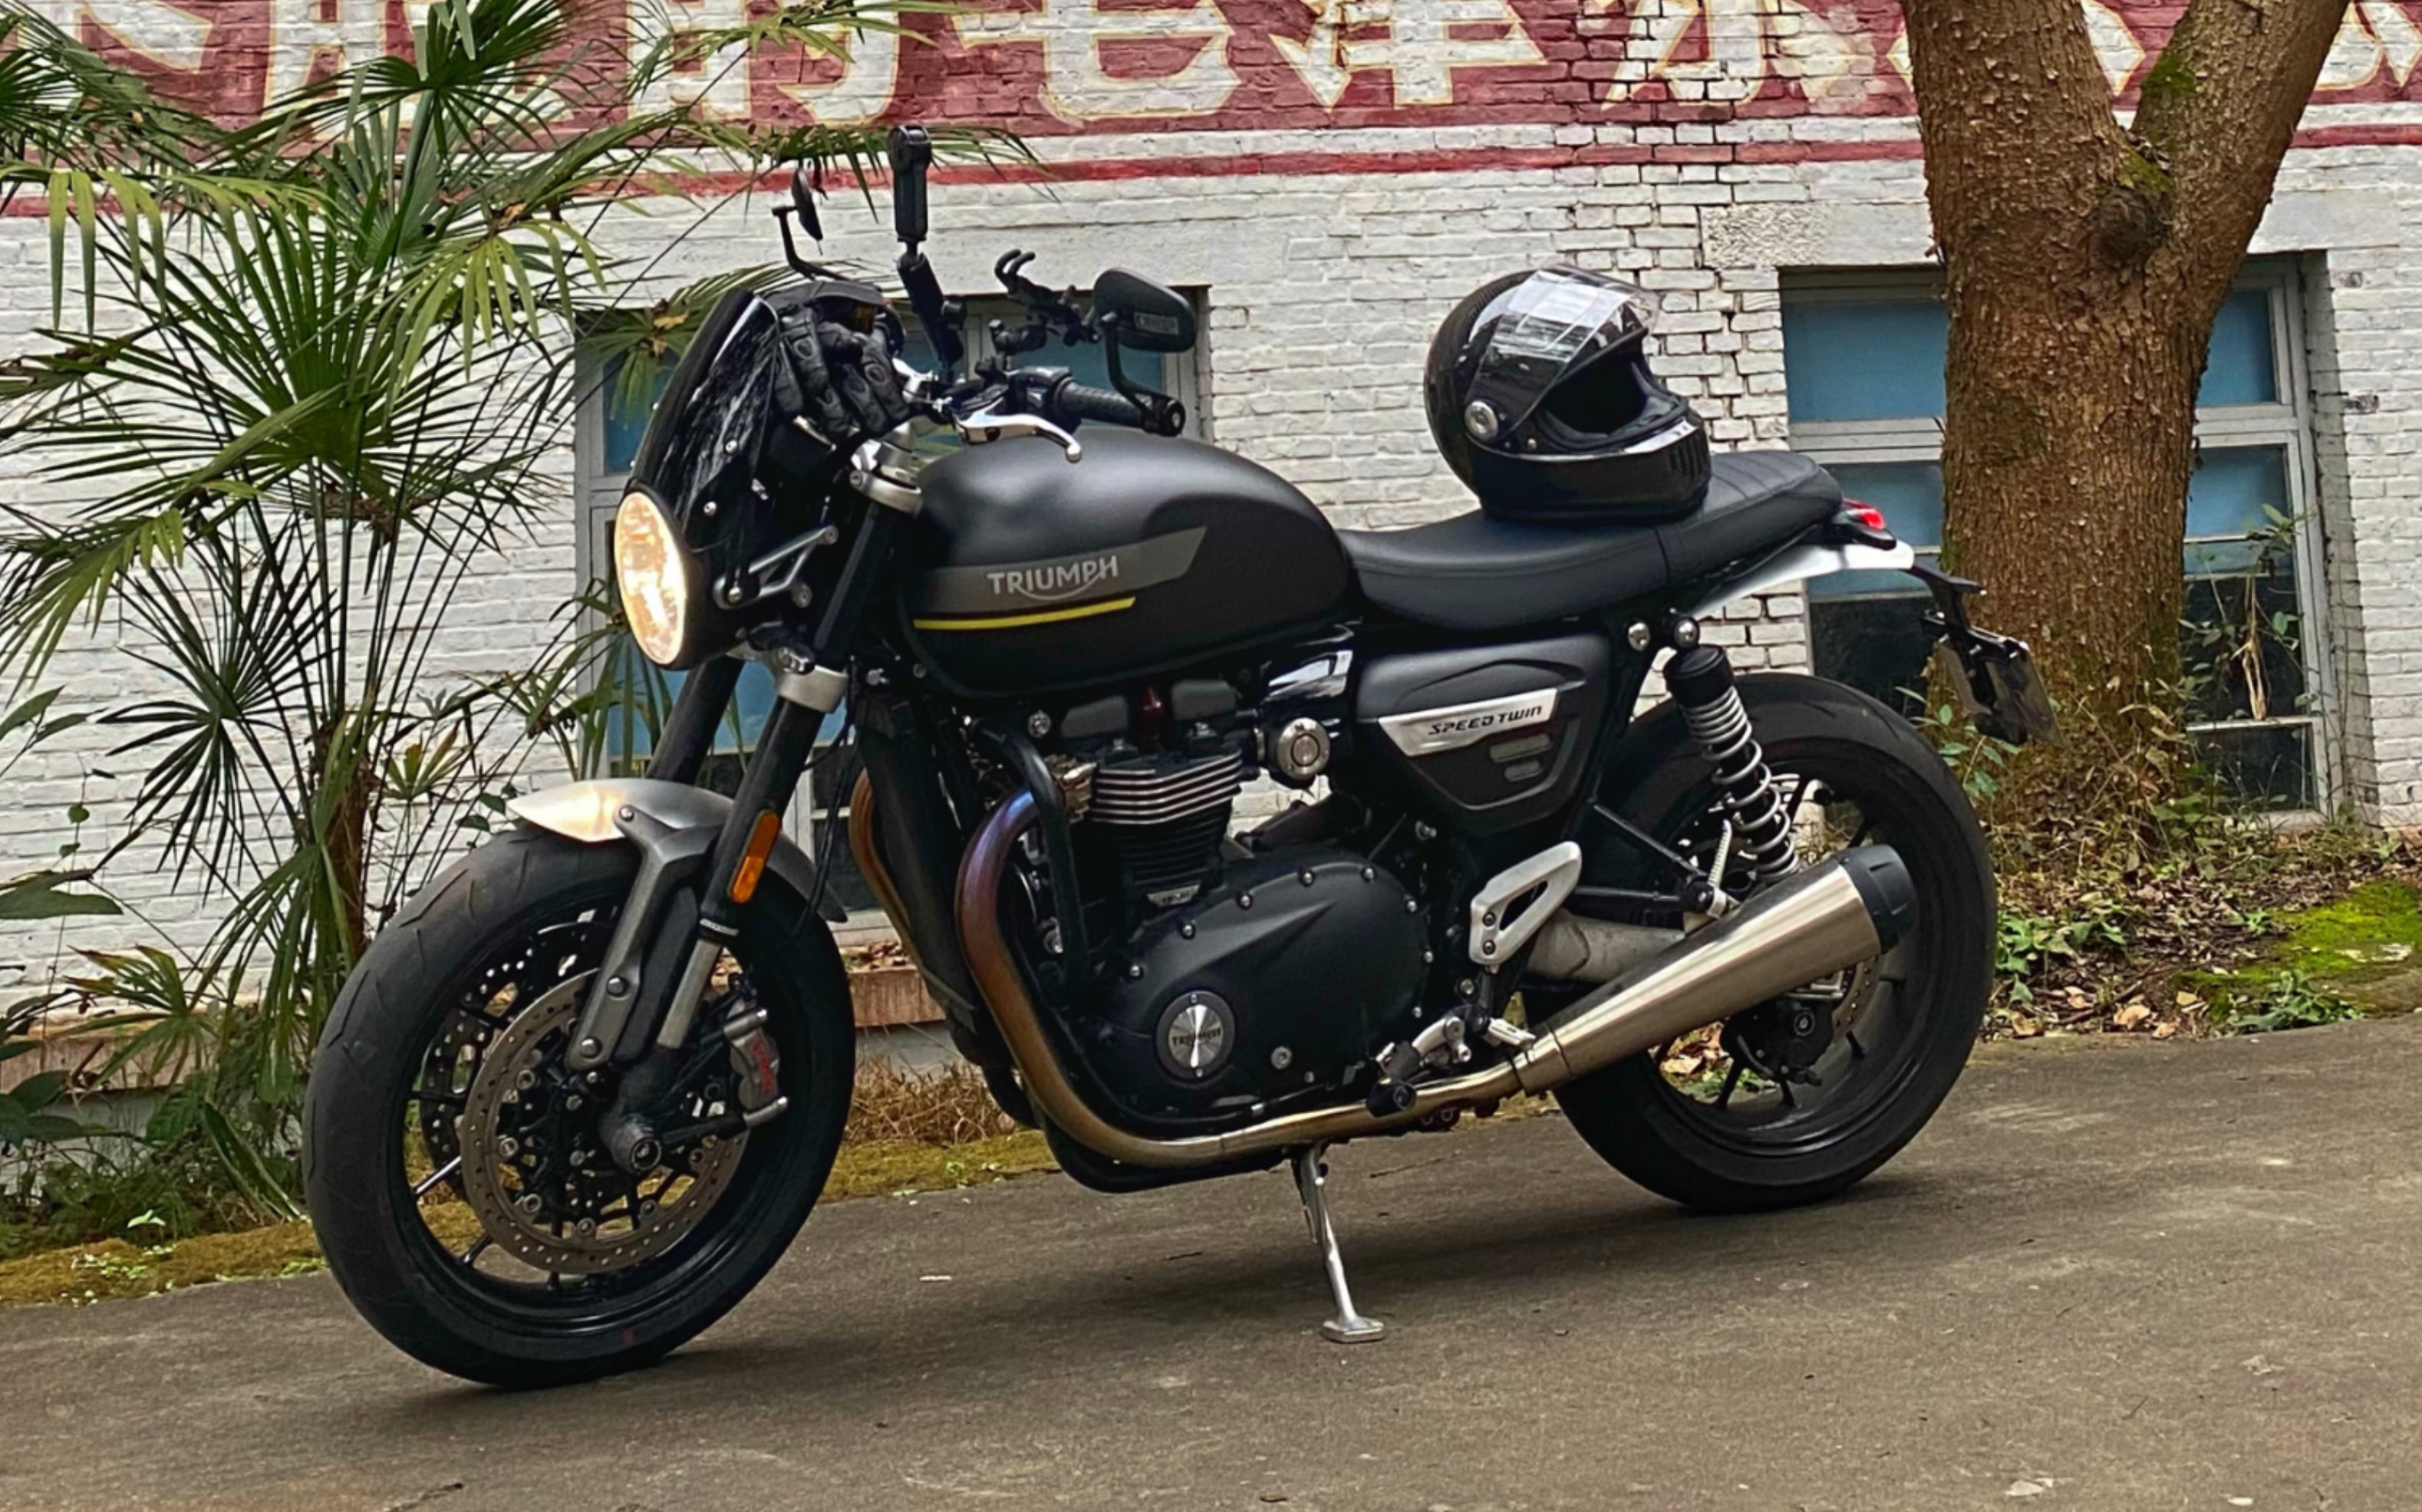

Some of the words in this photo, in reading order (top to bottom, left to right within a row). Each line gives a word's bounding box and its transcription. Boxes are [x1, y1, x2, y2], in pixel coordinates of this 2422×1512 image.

[987, 555, 1119, 600] TRIUMPH
[1428, 715, 1494, 736] SPEED
[1498, 705, 1542, 723] TWIN
